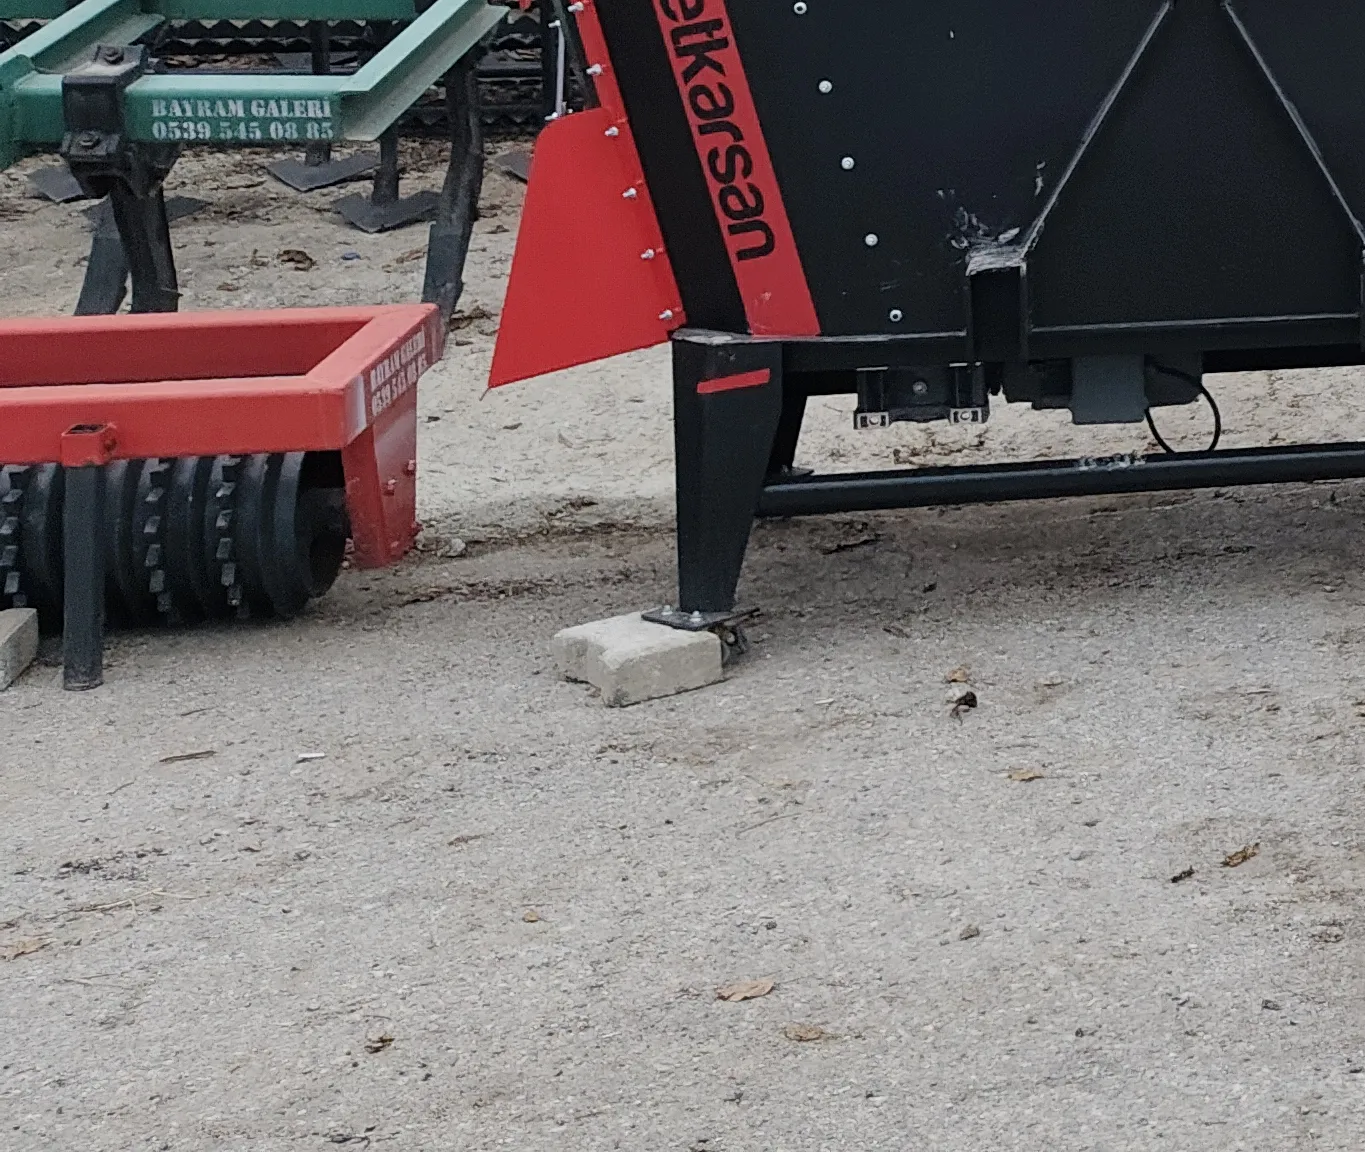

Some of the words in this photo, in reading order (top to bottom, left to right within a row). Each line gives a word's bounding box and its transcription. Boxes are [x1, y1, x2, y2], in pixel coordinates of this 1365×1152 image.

[152, 99, 244, 118] BAYRAM
[152, 121, 210, 140] 0539
[219, 121, 261, 140] 545
[269, 121, 298, 140] 08
[305, 121, 333, 140] 85
